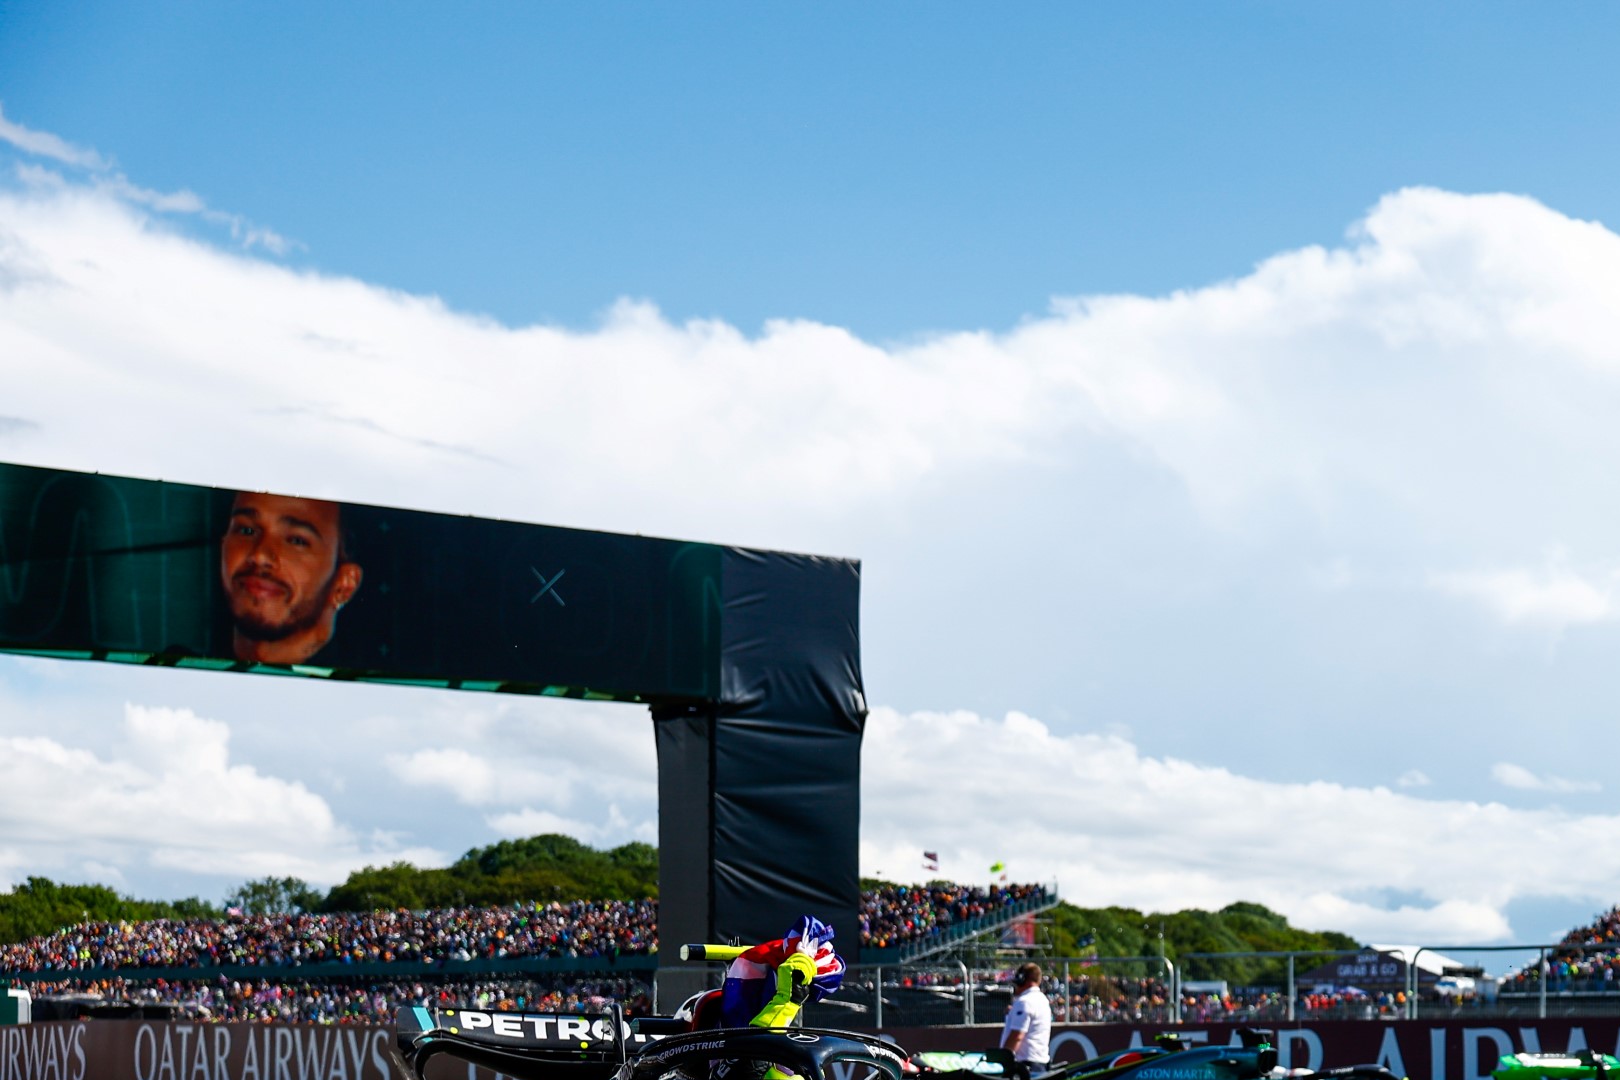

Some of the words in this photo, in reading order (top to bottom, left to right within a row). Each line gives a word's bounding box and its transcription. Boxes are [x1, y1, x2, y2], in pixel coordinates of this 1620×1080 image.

[459, 1011, 666, 1042] PETRO
[660, 1040, 726, 1061] CROWDSTRIKE
[1135, 1068, 1171, 1080] ASTON
[1174, 1068, 1216, 1080] MARTIN
